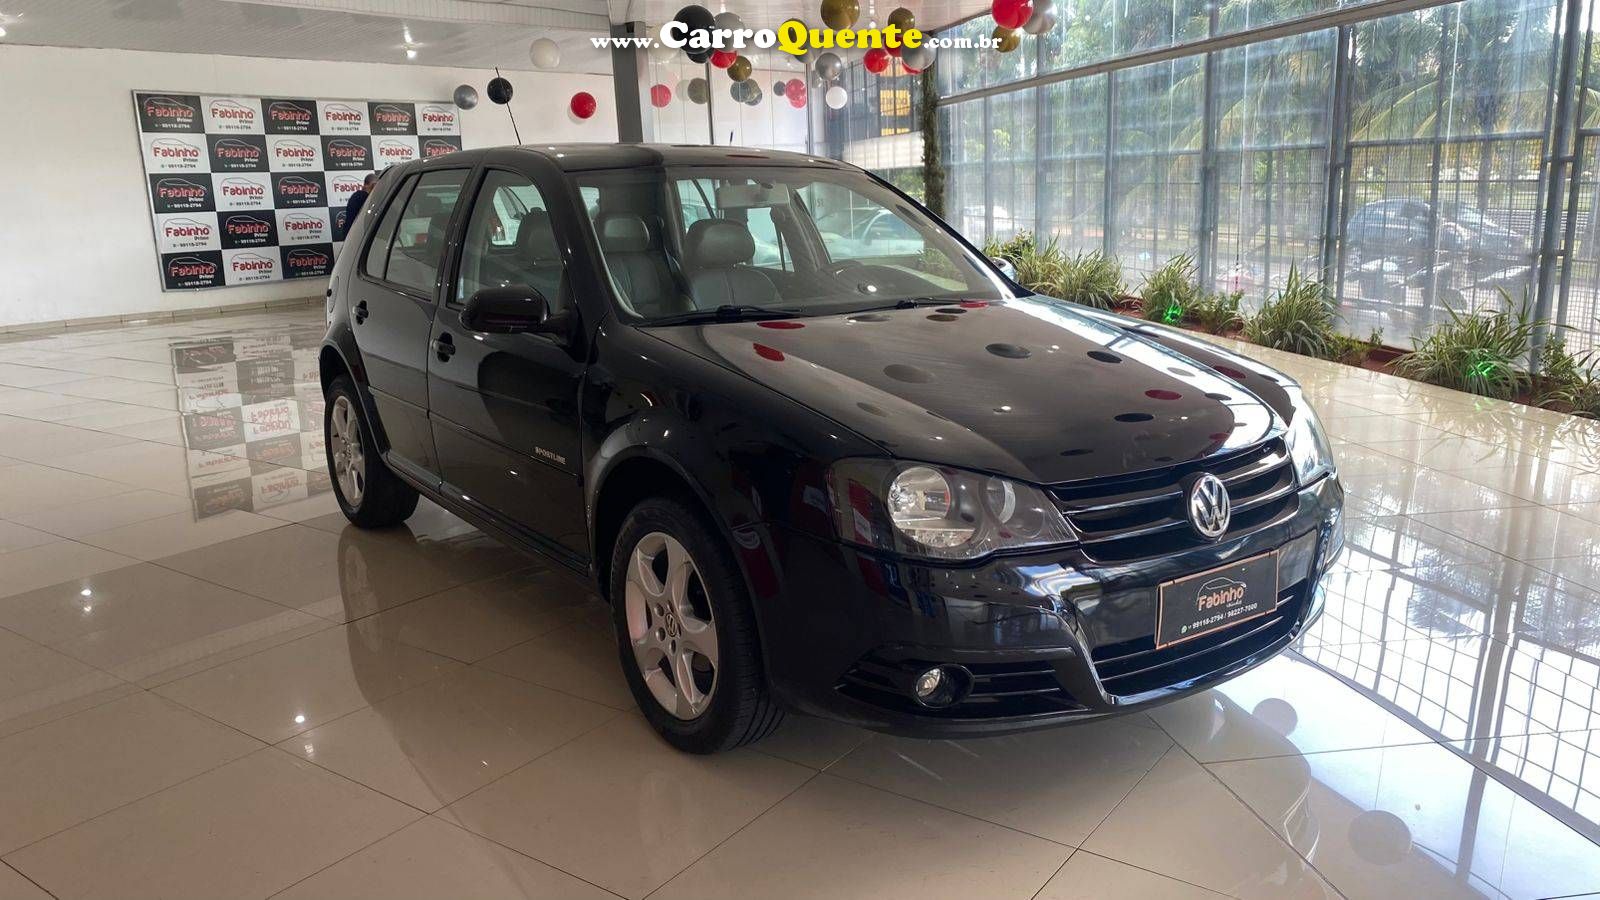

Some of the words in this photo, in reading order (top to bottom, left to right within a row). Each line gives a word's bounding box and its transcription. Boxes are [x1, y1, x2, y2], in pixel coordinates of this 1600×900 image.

[147, 107, 193, 118] Fabinho
[212, 109, 254, 118] Fabinho
[272, 110, 310, 120] Fabinho
[326, 112, 361, 120] Fabinho
[376, 113, 410, 122] Fabinho
[422, 113, 454, 122] Fabinho
[153, 148, 199, 158] Fabinho
[216, 148, 260, 158] Fabinho
[276, 148, 314, 157] Fabinho
[330, 149, 366, 157] Fabinho
[380, 148, 412, 156] Fabinho
[160, 187, 205, 198] Fabinho
[223, 186, 263, 196] Fabinho
[281, 184, 318, 195] Fabinho
[334, 183, 364, 192] Fabinh
[228, 224, 269, 234] Fabinho
[285, 221, 323, 231] Fabinho
[166, 227, 209, 237] Fabinho
[233, 261, 273, 271] Fabinho
[289, 257, 326, 268] Fabinho
[172, 264, 215, 277] Fabinho
[1198, 586, 1244, 611] Fabinho
